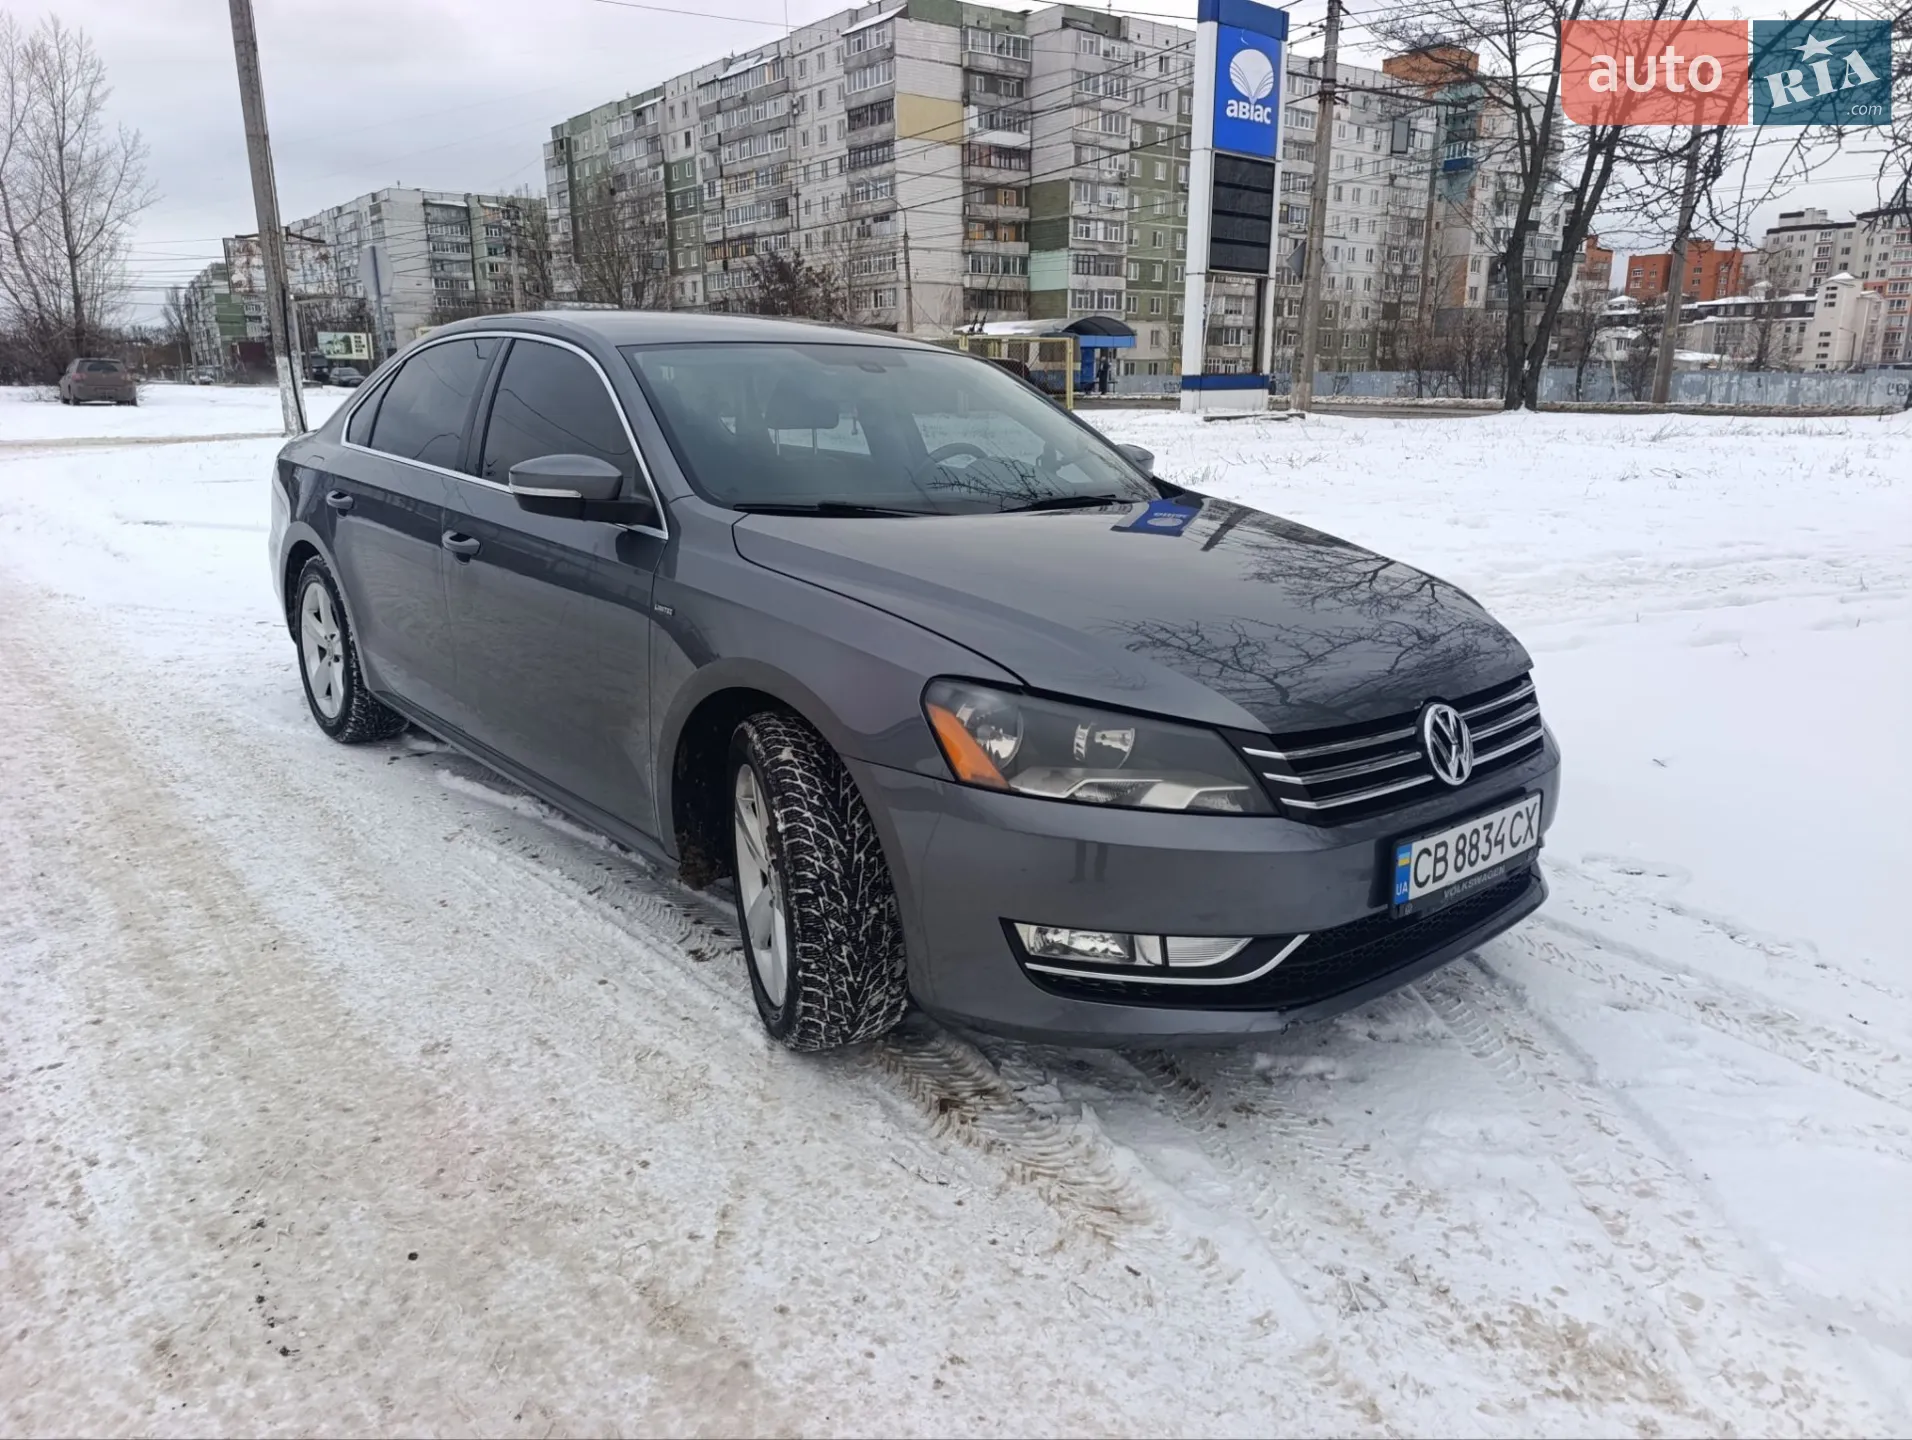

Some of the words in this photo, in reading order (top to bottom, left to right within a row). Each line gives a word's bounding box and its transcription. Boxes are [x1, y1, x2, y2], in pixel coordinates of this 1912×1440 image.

[1413, 840, 1449, 889] CB
[1454, 816, 1506, 873] 8834
[1509, 802, 1538, 848] CX
[1396, 883, 1408, 896] UA
[1443, 865, 1506, 899] VOLKSWAGEN
